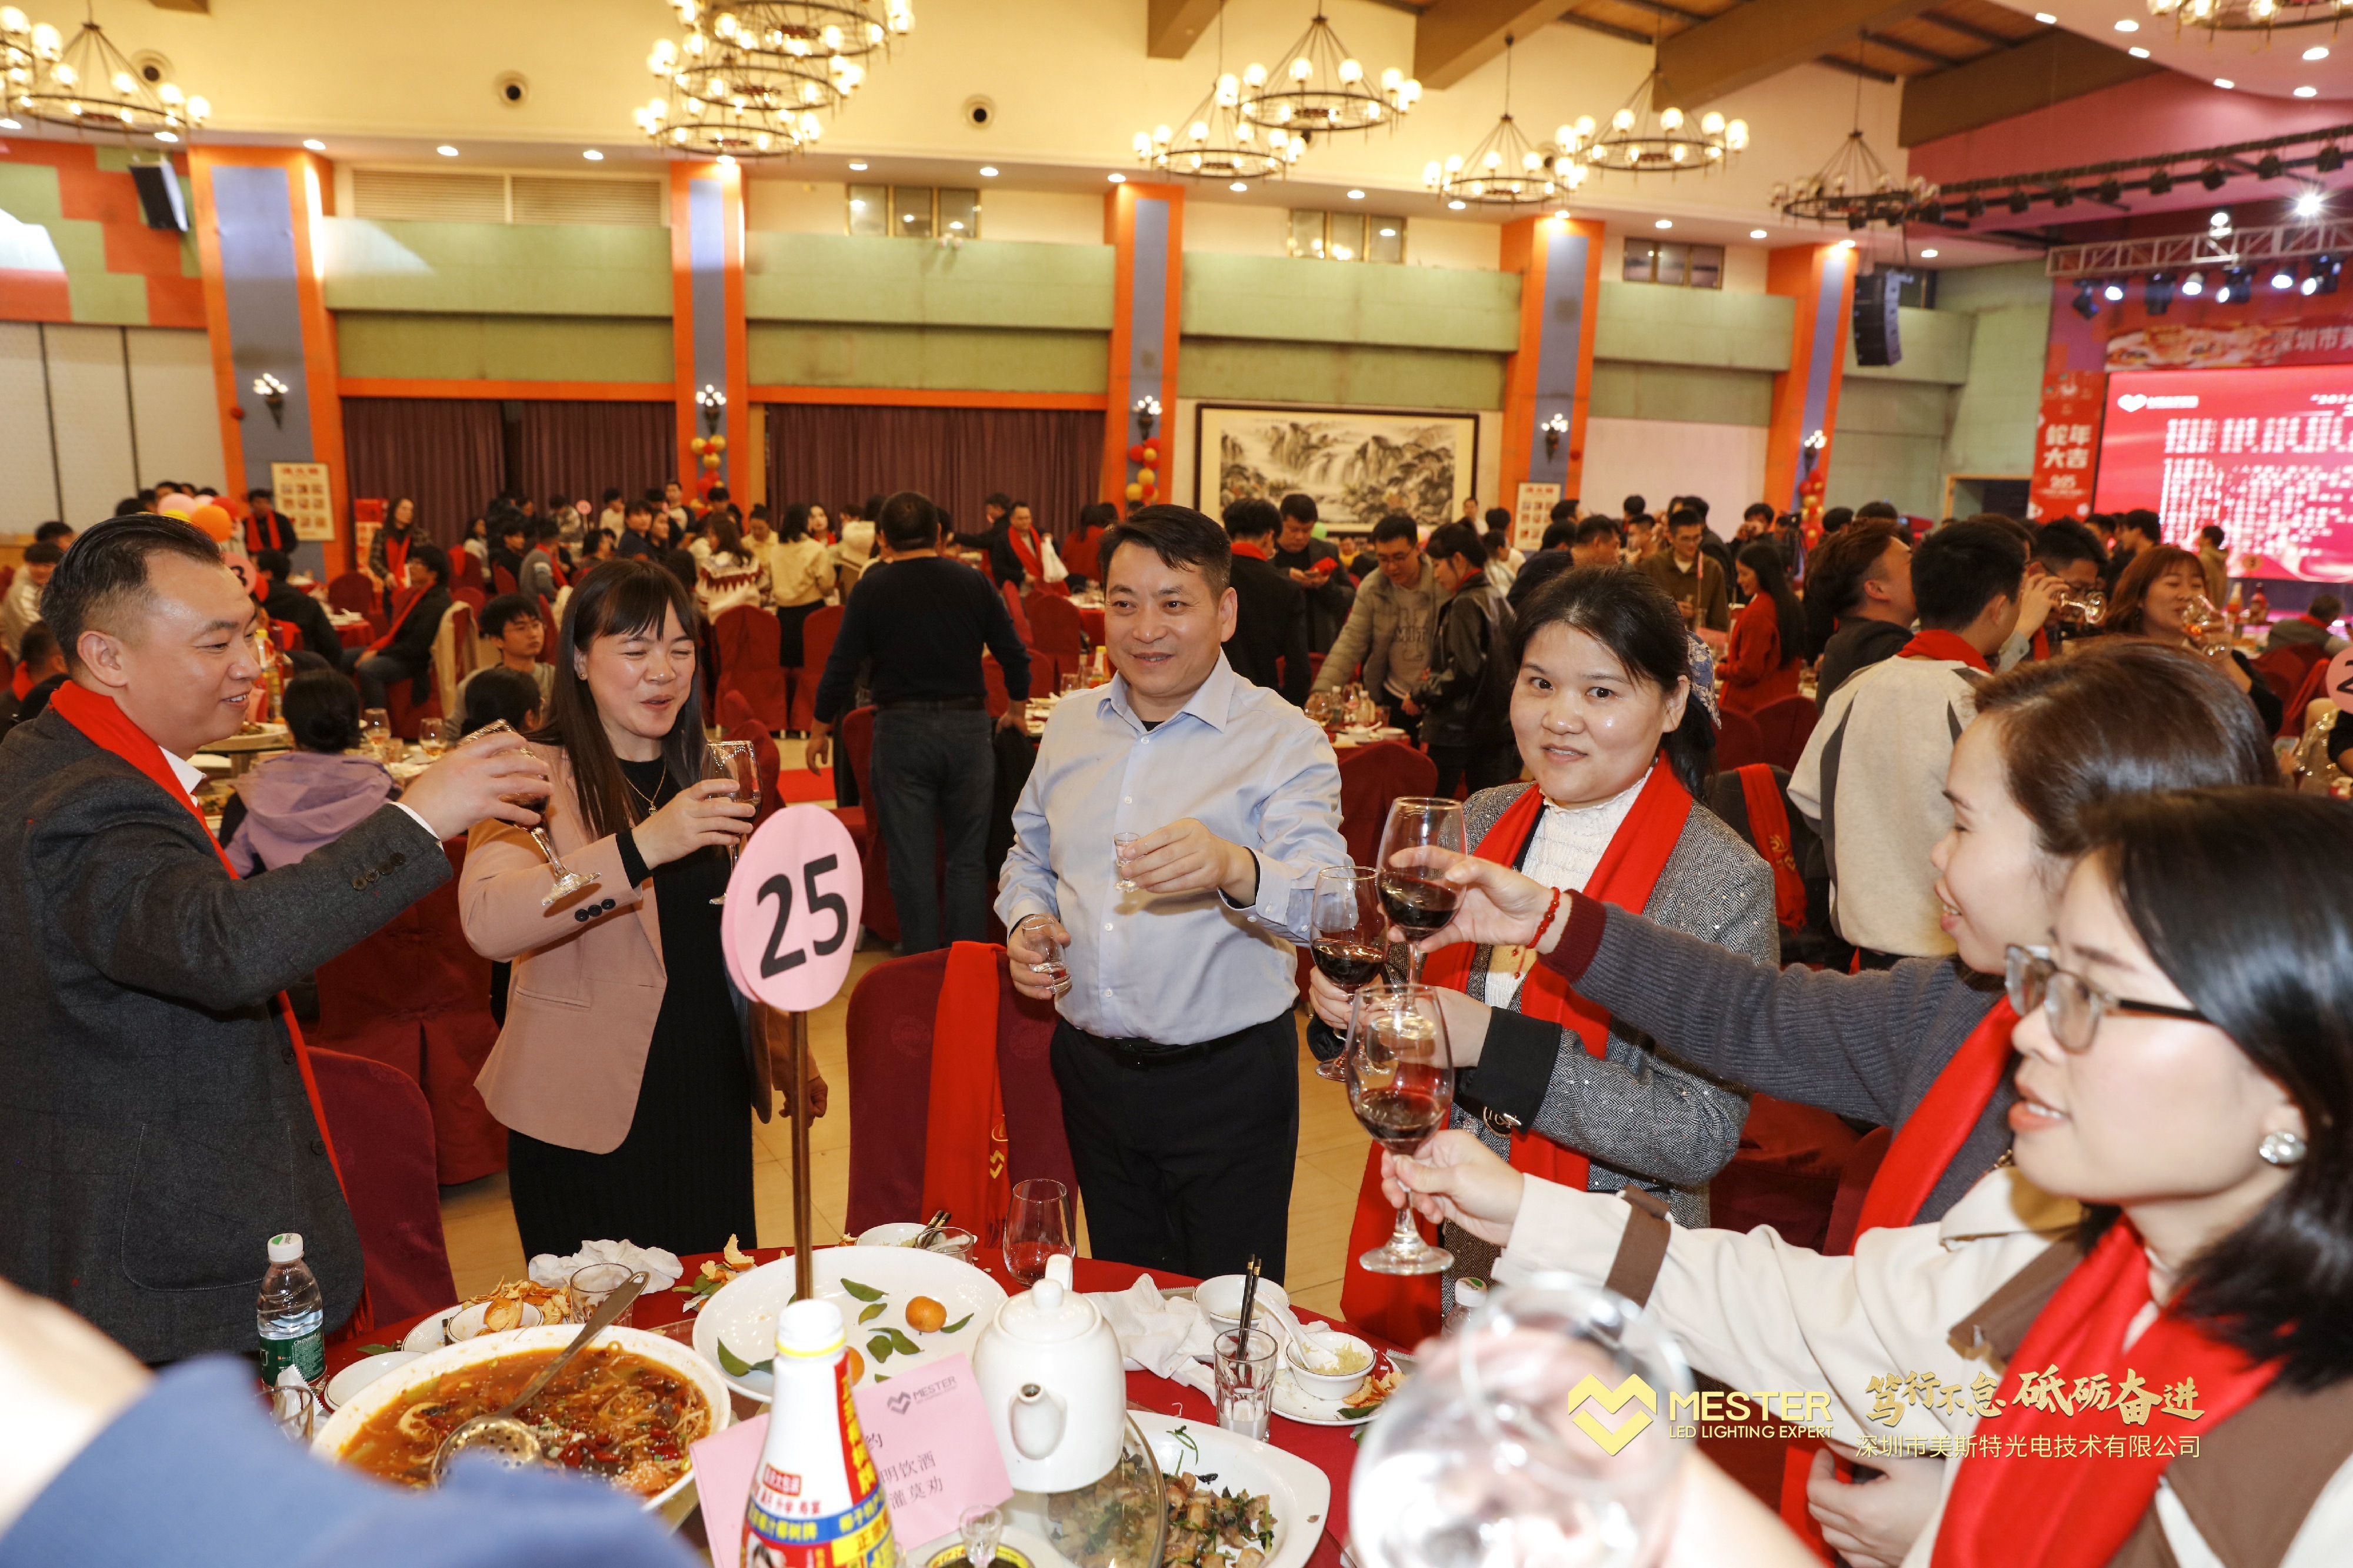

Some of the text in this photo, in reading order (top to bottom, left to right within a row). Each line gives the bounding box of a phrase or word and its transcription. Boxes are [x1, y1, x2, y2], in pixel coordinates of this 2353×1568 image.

[2045, 423, 2092, 446] 蛇年
[2042, 447, 2089, 469] 大吉
[757, 853, 849, 980] 25
[913, 1376, 957, 1400] MESTER
[880, 1450, 936, 1483] 明饮酒
[889, 1476, 944, 1510] 灌莫劝
